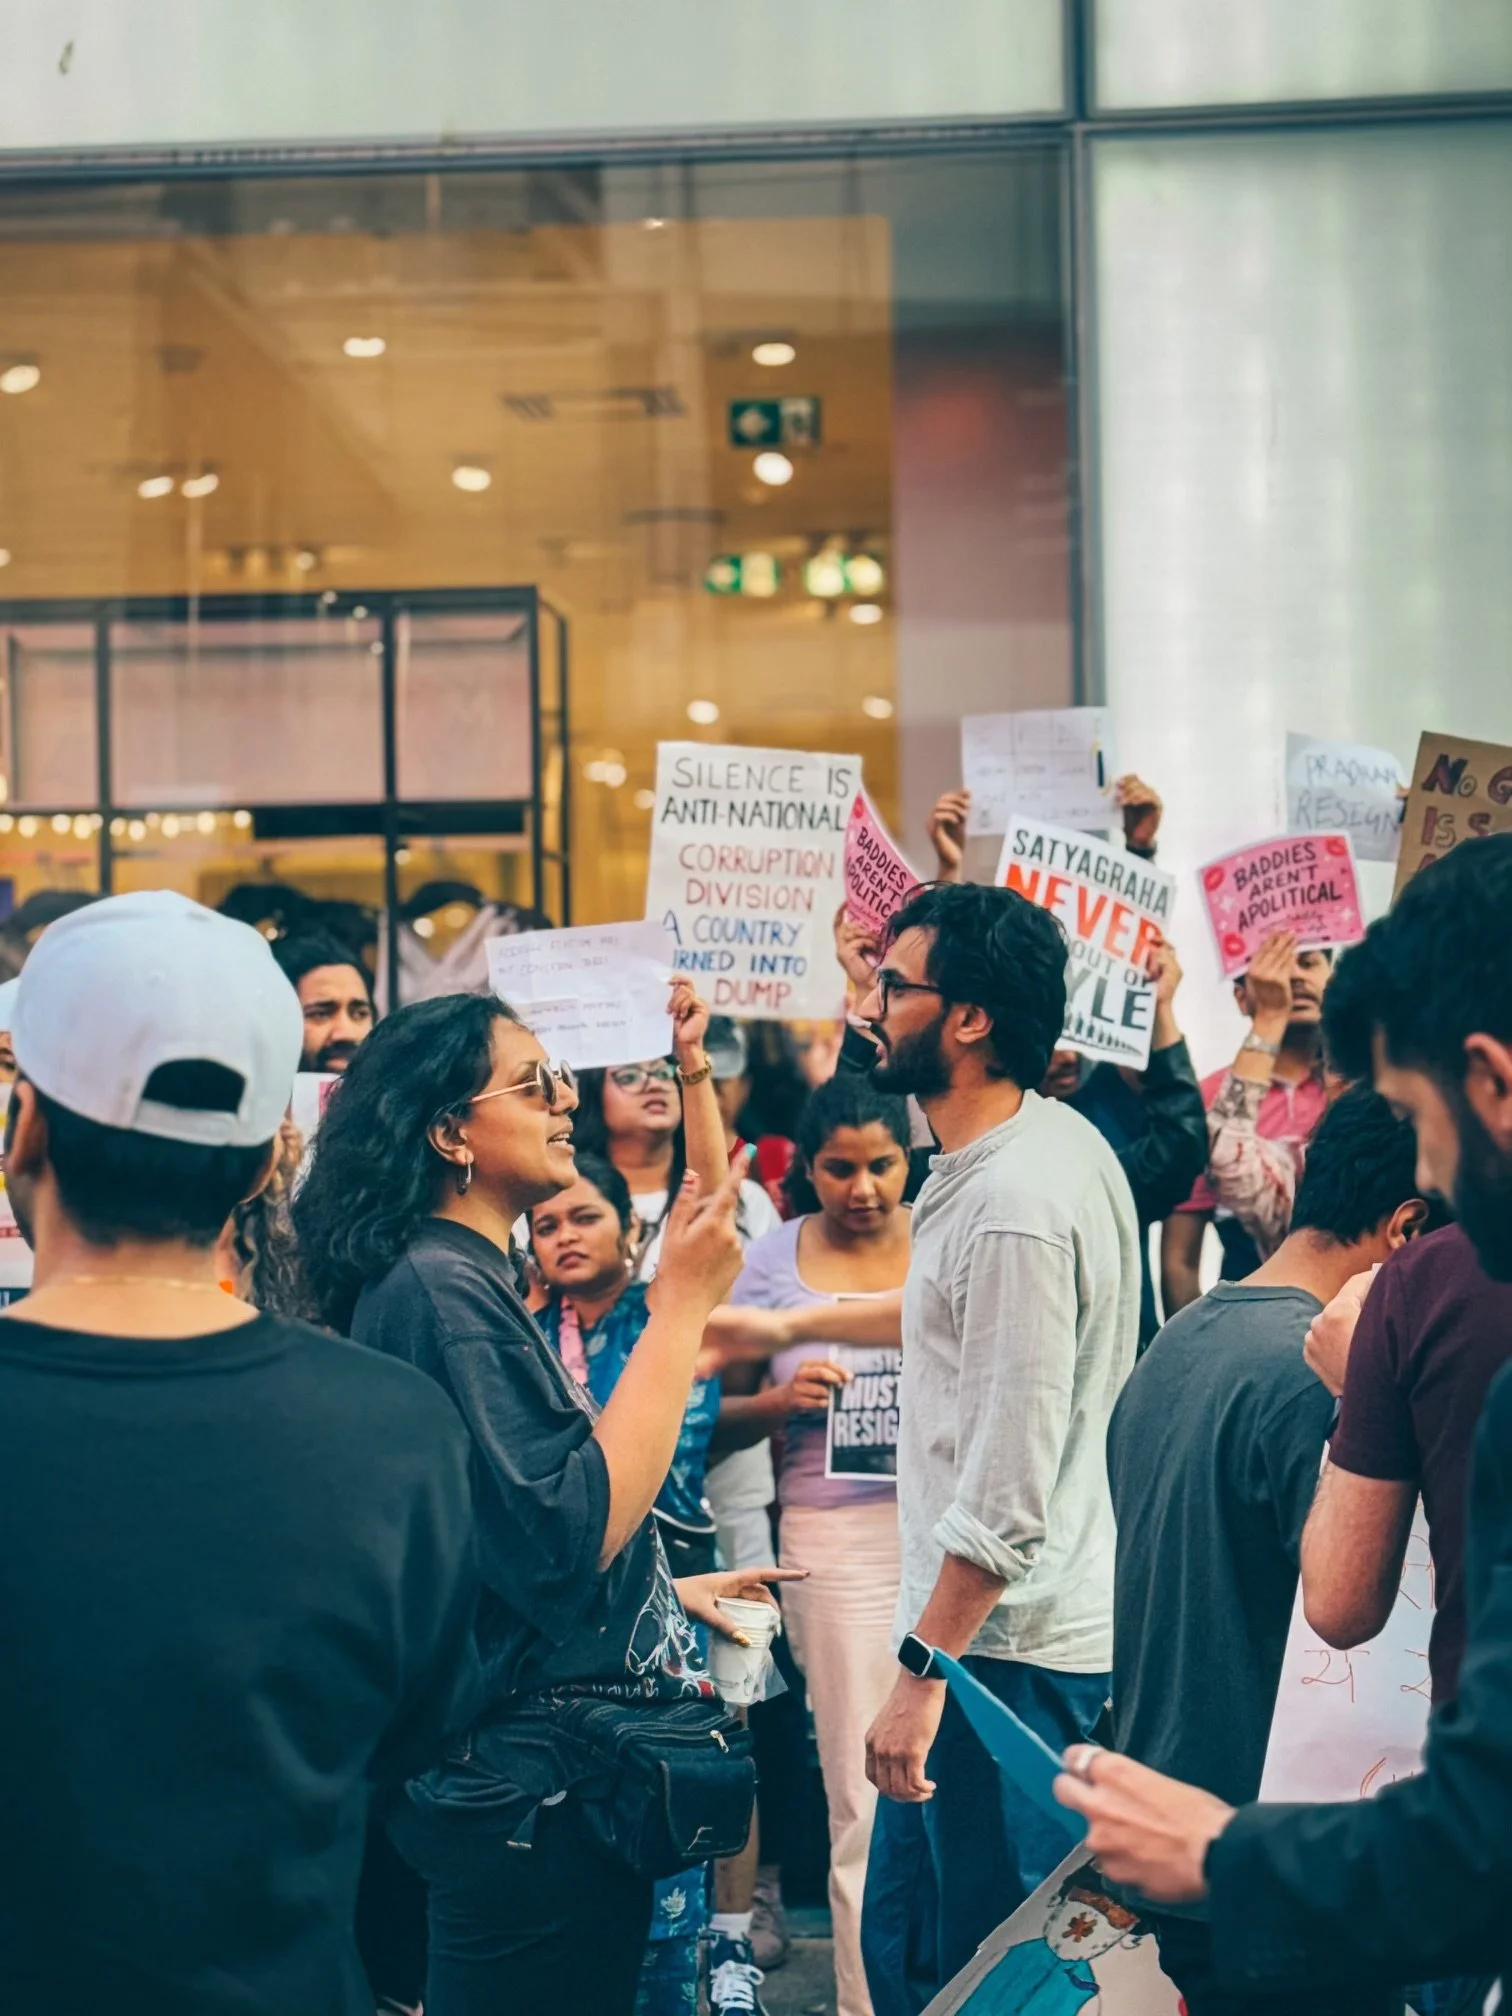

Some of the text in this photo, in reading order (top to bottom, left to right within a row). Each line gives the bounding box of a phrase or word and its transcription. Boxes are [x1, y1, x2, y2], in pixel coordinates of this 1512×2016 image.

[672, 756, 852, 798] SILENCE IS
[661, 796, 846, 831] ANTI-NATIONAL
[679, 843, 836, 879] CORRUPTION
[855, 855, 901, 903] AREN'T
[857, 826, 907, 890] BADDIES
[1012, 828, 1170, 919] SATYAGRAHA
[1232, 841, 1317, 892] BADDIES
[685, 878, 814, 912] DIVISION
[846, 856, 892, 919] APOLITIC
[1248, 863, 1319, 901] AREN'T
[1005, 863, 1163, 967] NEVER
[1237, 879, 1343, 934] APOLITICAL
[693, 916, 804, 947] COUNTRY
[750, 952, 807, 975] INTO
[713, 979, 791, 1008] DUMP
[1064, 959, 1152, 1031] YLE
[833, 1410, 899, 1447] RESIG
